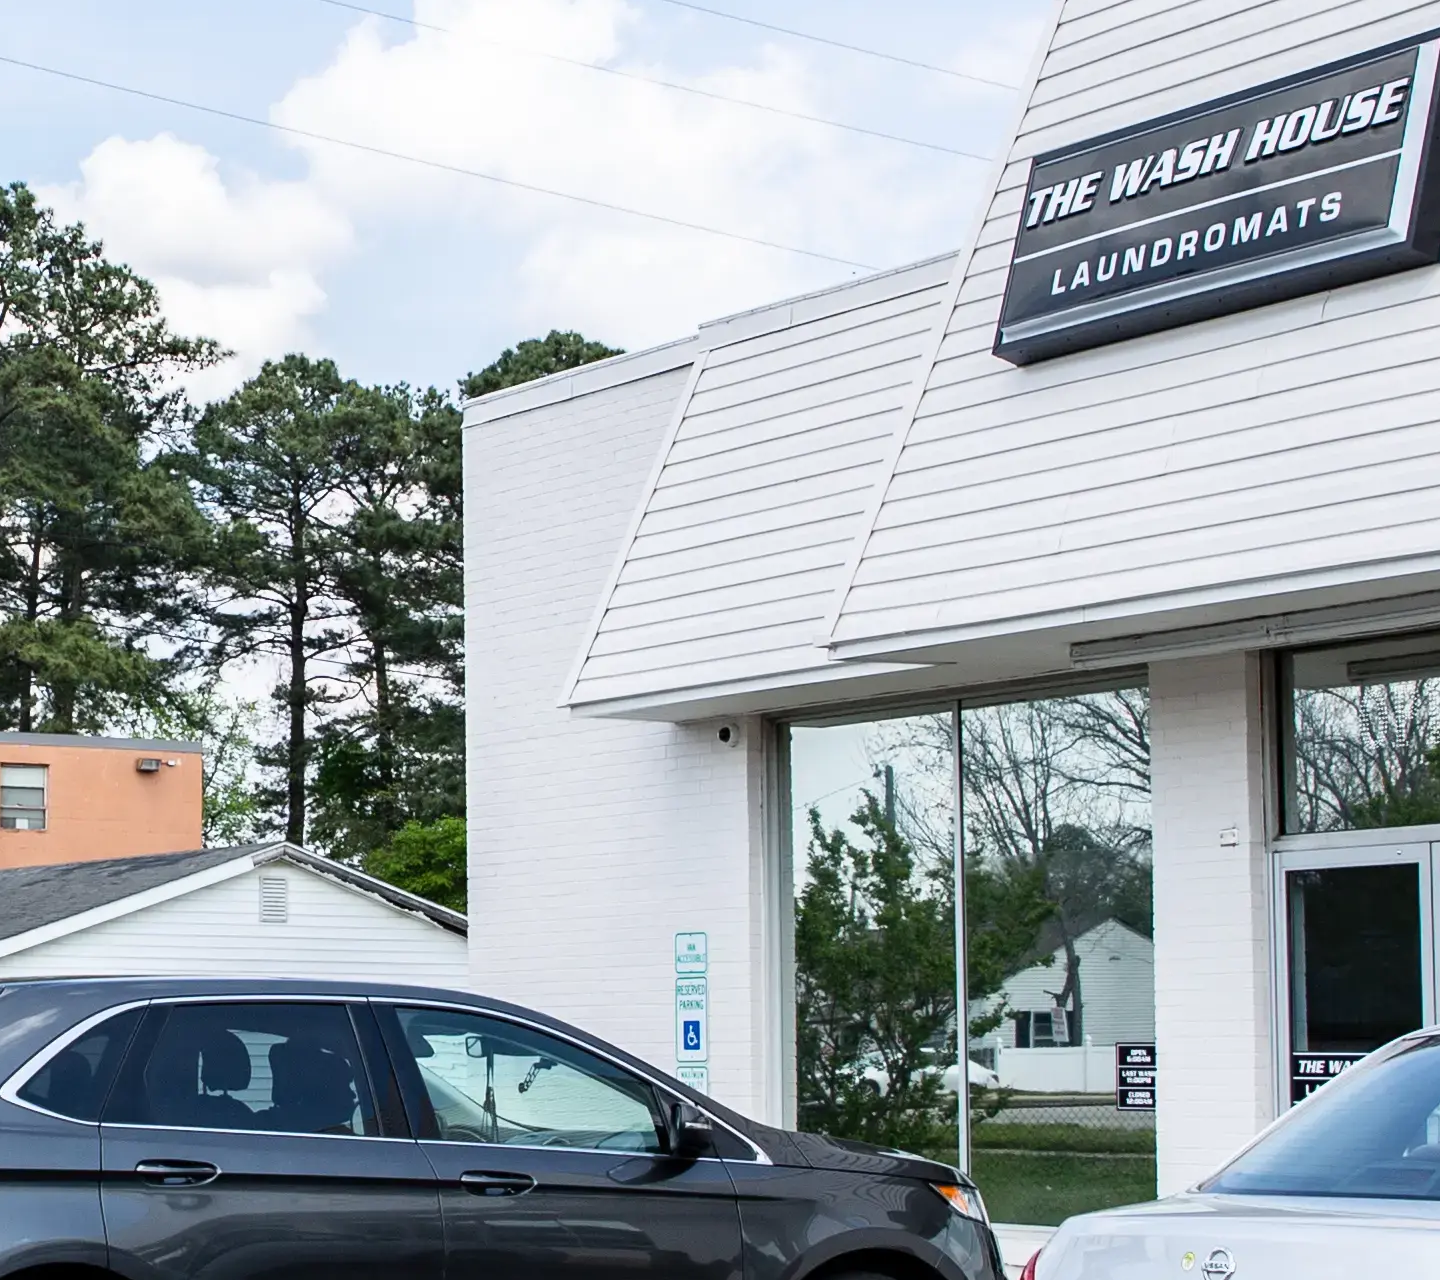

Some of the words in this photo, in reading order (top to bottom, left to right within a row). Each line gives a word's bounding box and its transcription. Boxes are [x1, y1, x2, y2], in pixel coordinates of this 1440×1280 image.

[1025, 171, 1102, 229] THE
[1109, 126, 1243, 201] WASH
[1245, 77, 1411, 162] HOUSE
[1050, 191, 1343, 297] LAUNDROMATS
[677, 984, 705, 996] RESERVED
[679, 999, 704, 1011] PARKING
[1298, 1060, 1326, 1074] THE
[1328, 1060, 1360, 1074] WA
